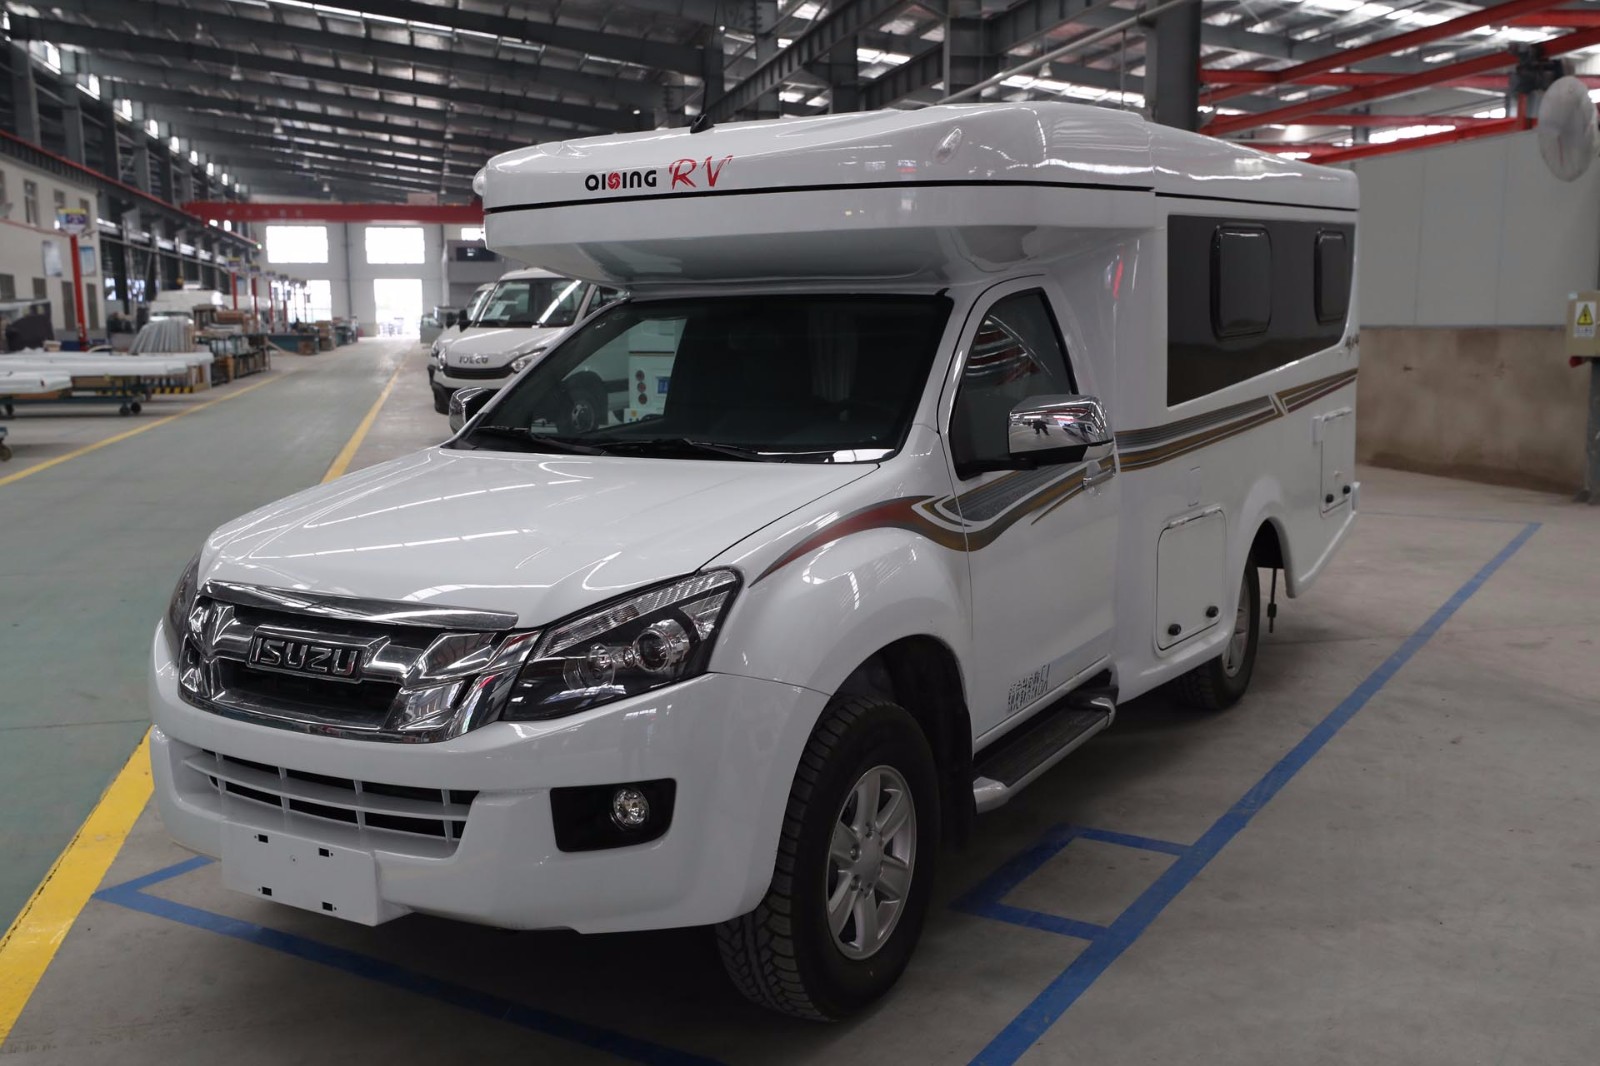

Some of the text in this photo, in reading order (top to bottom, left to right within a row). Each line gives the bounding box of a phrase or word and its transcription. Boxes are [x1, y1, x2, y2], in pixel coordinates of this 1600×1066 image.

[669, 155, 734, 190] RV
[459, 355, 489, 364] IVECO
[252, 637, 358, 676] ISUZU
